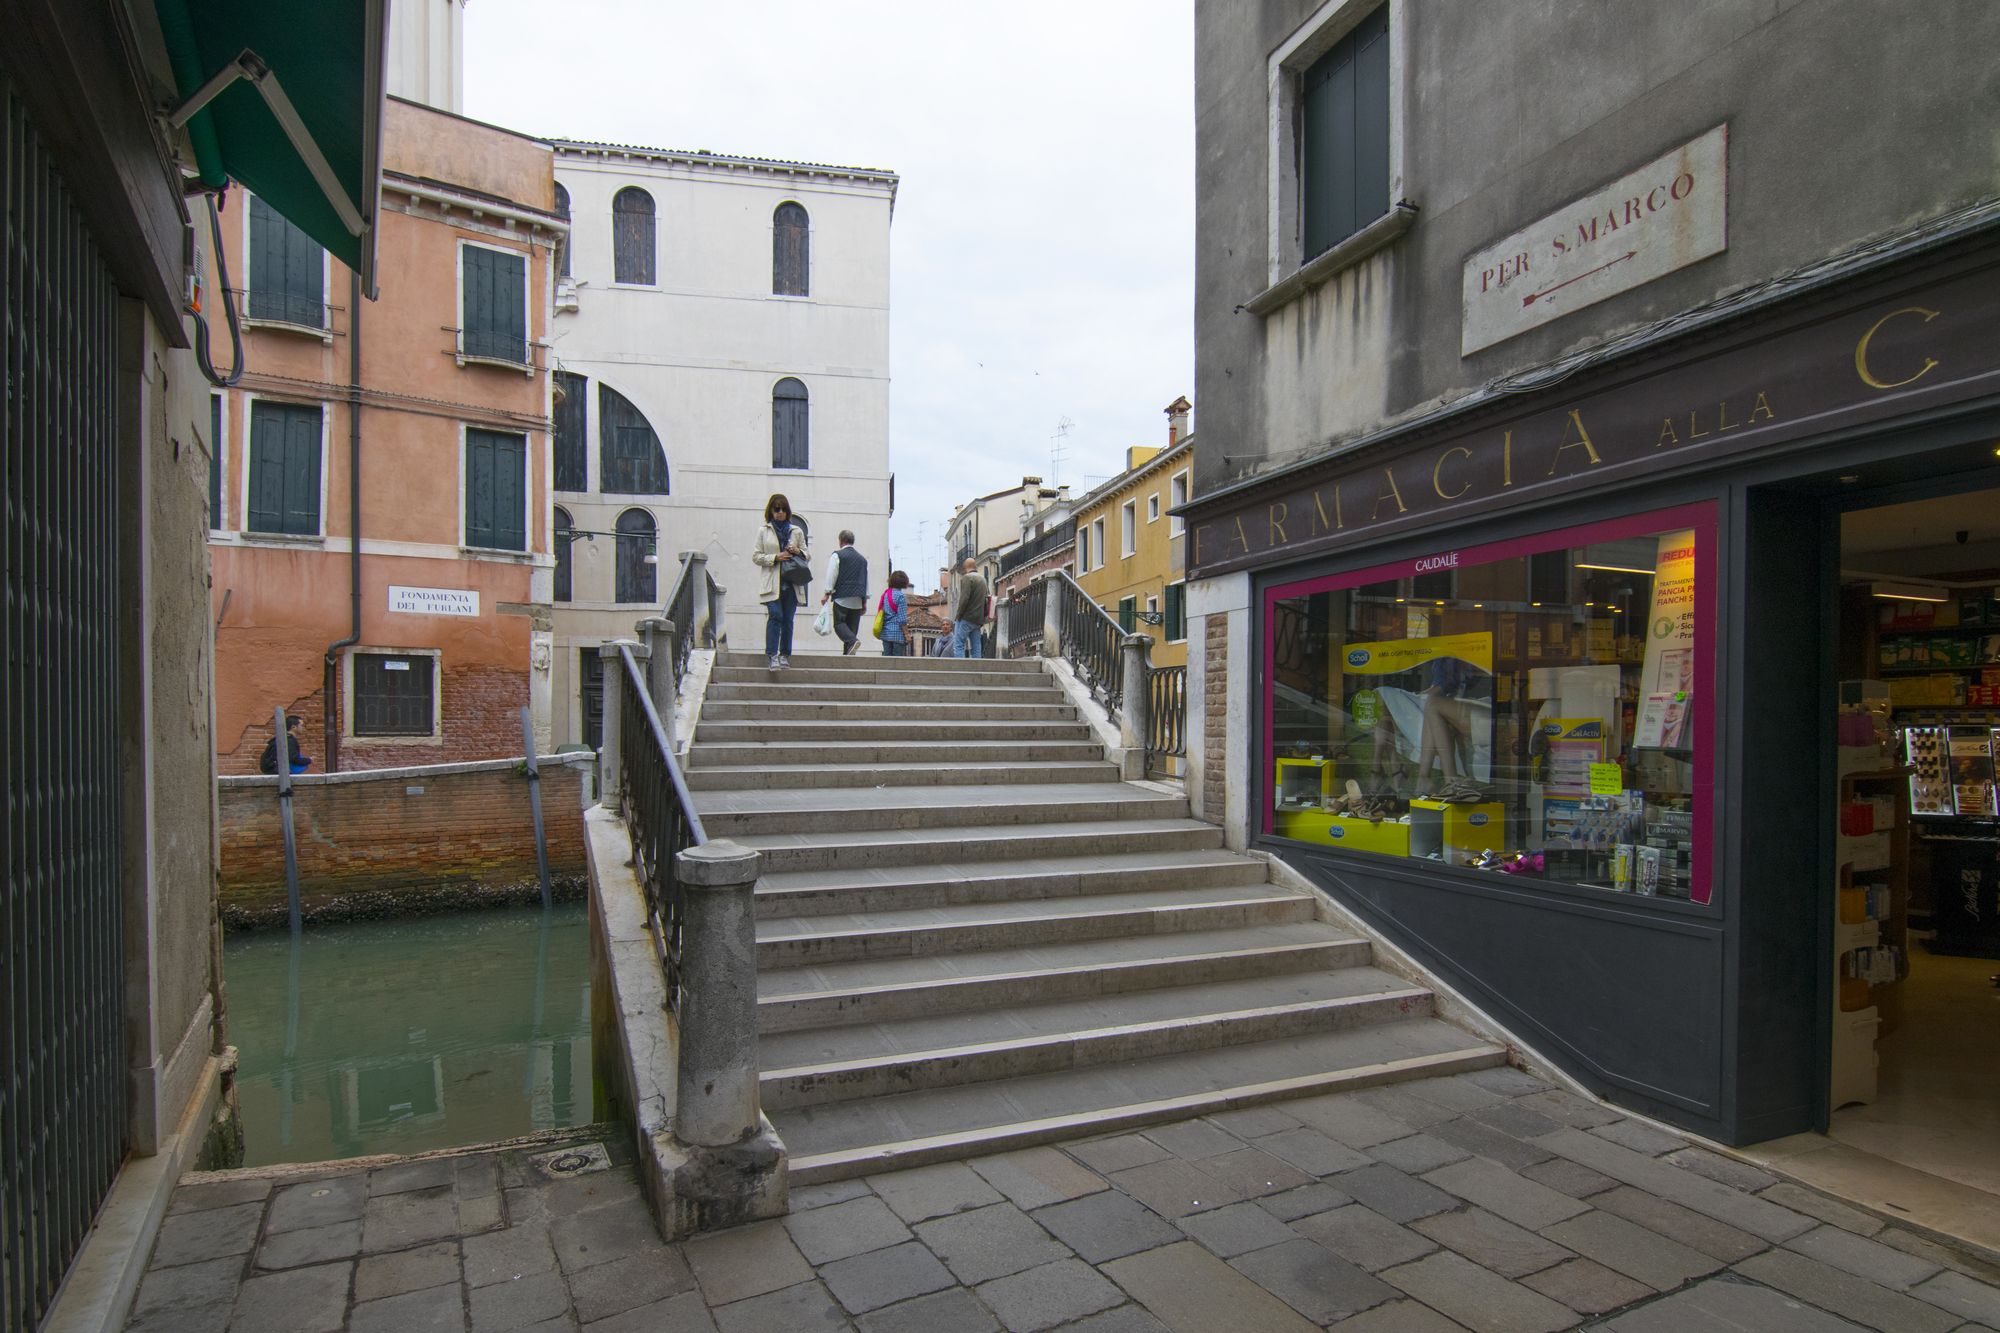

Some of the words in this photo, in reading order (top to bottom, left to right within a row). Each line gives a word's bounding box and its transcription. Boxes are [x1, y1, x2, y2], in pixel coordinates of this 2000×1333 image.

[1481, 252, 1530, 293] PER
[1196, 409, 1601, 566] FARMACIA
[1656, 391, 1774, 446] ALLA
[1855, 306, 1940, 389] C
[401, 591, 469, 602] FONDAMENTA
[1658, 586, 1685, 597] PANCIA
[1657, 595, 1687, 606] FIANCHI
[397, 601, 415, 610] DEI
[427, 603, 472, 613] FURLANI
[1349, 653, 1369, 663] Scholl
